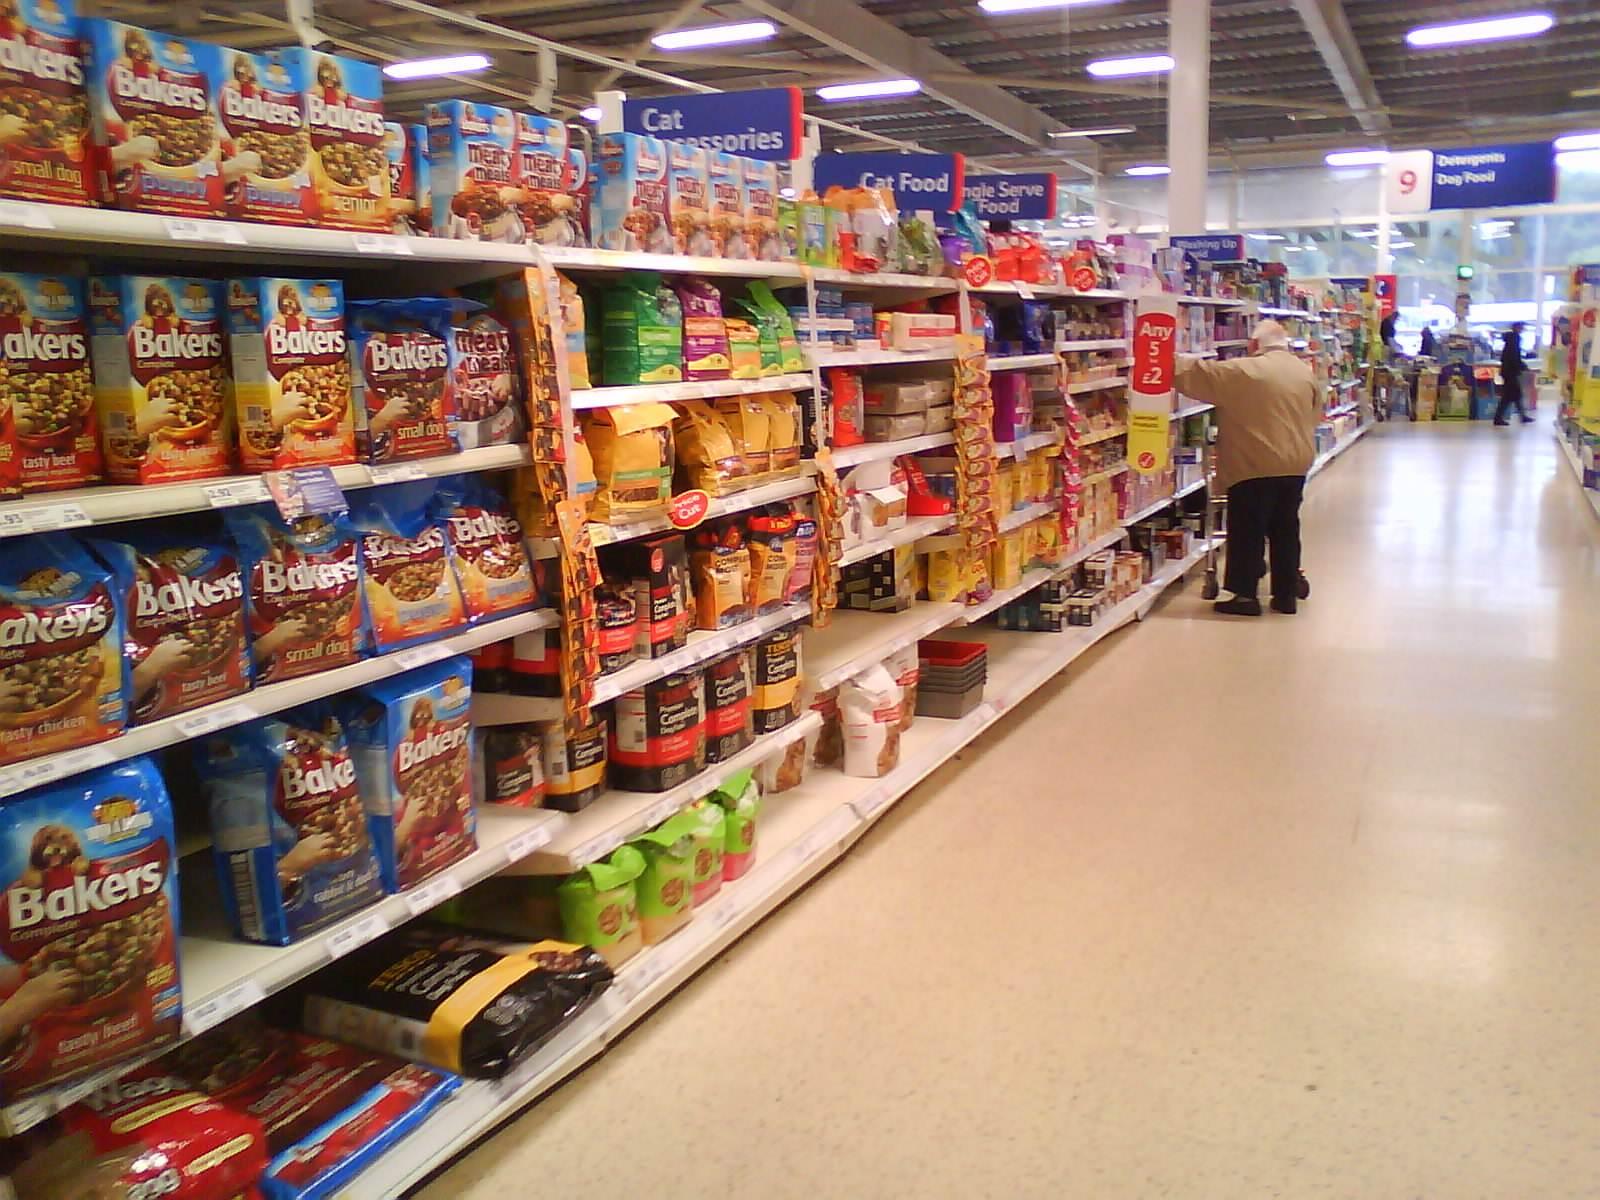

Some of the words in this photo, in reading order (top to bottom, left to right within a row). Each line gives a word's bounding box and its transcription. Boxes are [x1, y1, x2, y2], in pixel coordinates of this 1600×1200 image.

[0, 33, 85, 85] akers
[113, 65, 207, 111] Bakers
[224, 87, 300, 127] Bakers
[305, 94, 384, 136] Bakers
[641, 107, 684, 132] Cat
[668, 127, 784, 152] essories
[13, 160, 53, 179] small
[56, 163, 82, 188] dog
[860, 172, 894, 192] Cat
[900, 172, 949, 193] Food
[1400, 170, 1417, 194] 9
[1436, 172, 1462, 186] Dog
[1463, 169, 1496, 183] Food
[963, 183, 995, 199] ngle
[999, 181, 1045, 198] Serve
[979, 199, 1020, 214] Food
[3, 324, 87, 361] akers
[135, 324, 223, 359] Bakers
[270, 324, 346, 355] Bakers
[1139, 321, 1174, 341] Any
[371, 340, 448, 372] Bakers
[1148, 341, 1160, 356] 5
[1142, 367, 1163, 384] £2
[397, 425, 424, 440] small
[679, 504, 702, 520] Cut
[262, 556, 358, 593] Bakers
[136, 572, 243, 617] Bakers
[0, 603, 108, 648] akers
[286, 646, 323, 663] small
[325, 641, 349, 658] dog
[38, 715, 87, 734] chicken
[281, 758, 357, 800] Bake
[7, 860, 163, 930] Bakers
